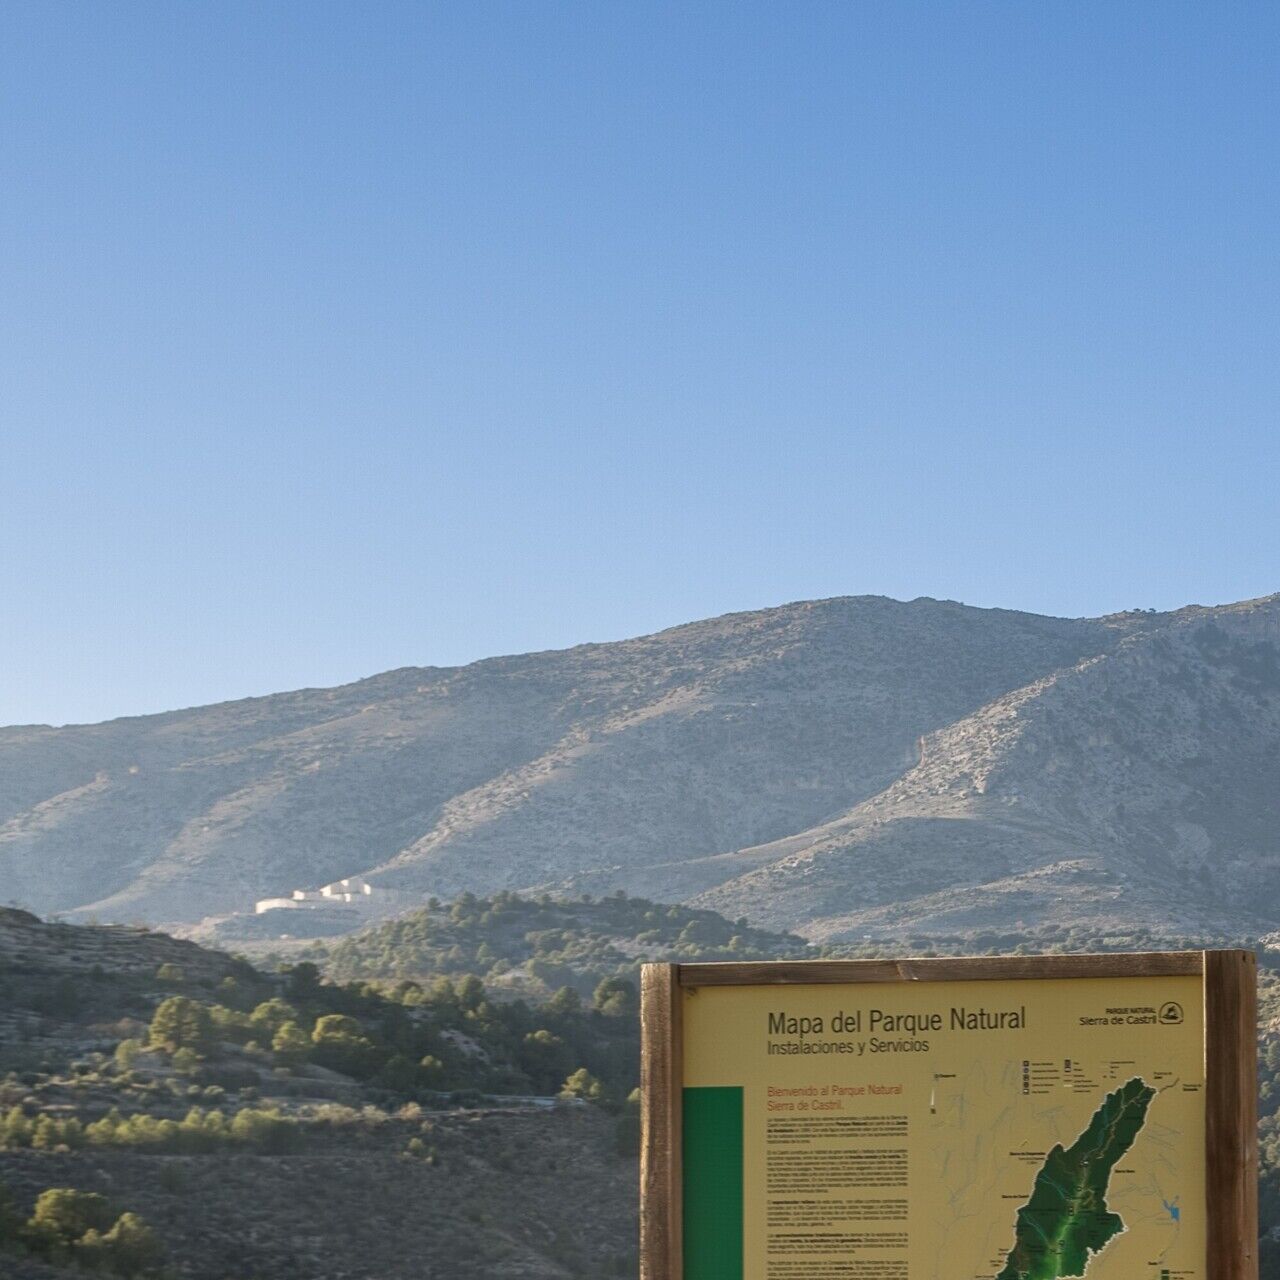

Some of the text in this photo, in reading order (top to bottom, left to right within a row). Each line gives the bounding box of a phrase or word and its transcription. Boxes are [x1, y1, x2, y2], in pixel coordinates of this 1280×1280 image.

[768, 1006, 1025, 1038] Mapa del Parque Natural
[1080, 1015, 1156, 1026] Sierra de Castril
[768, 1038, 929, 1056] Instalaciones y Servicios
[768, 1084, 902, 1098] Bienvenido al Parque Natural
[768, 1100, 844, 1111] Sierra de Castril.
